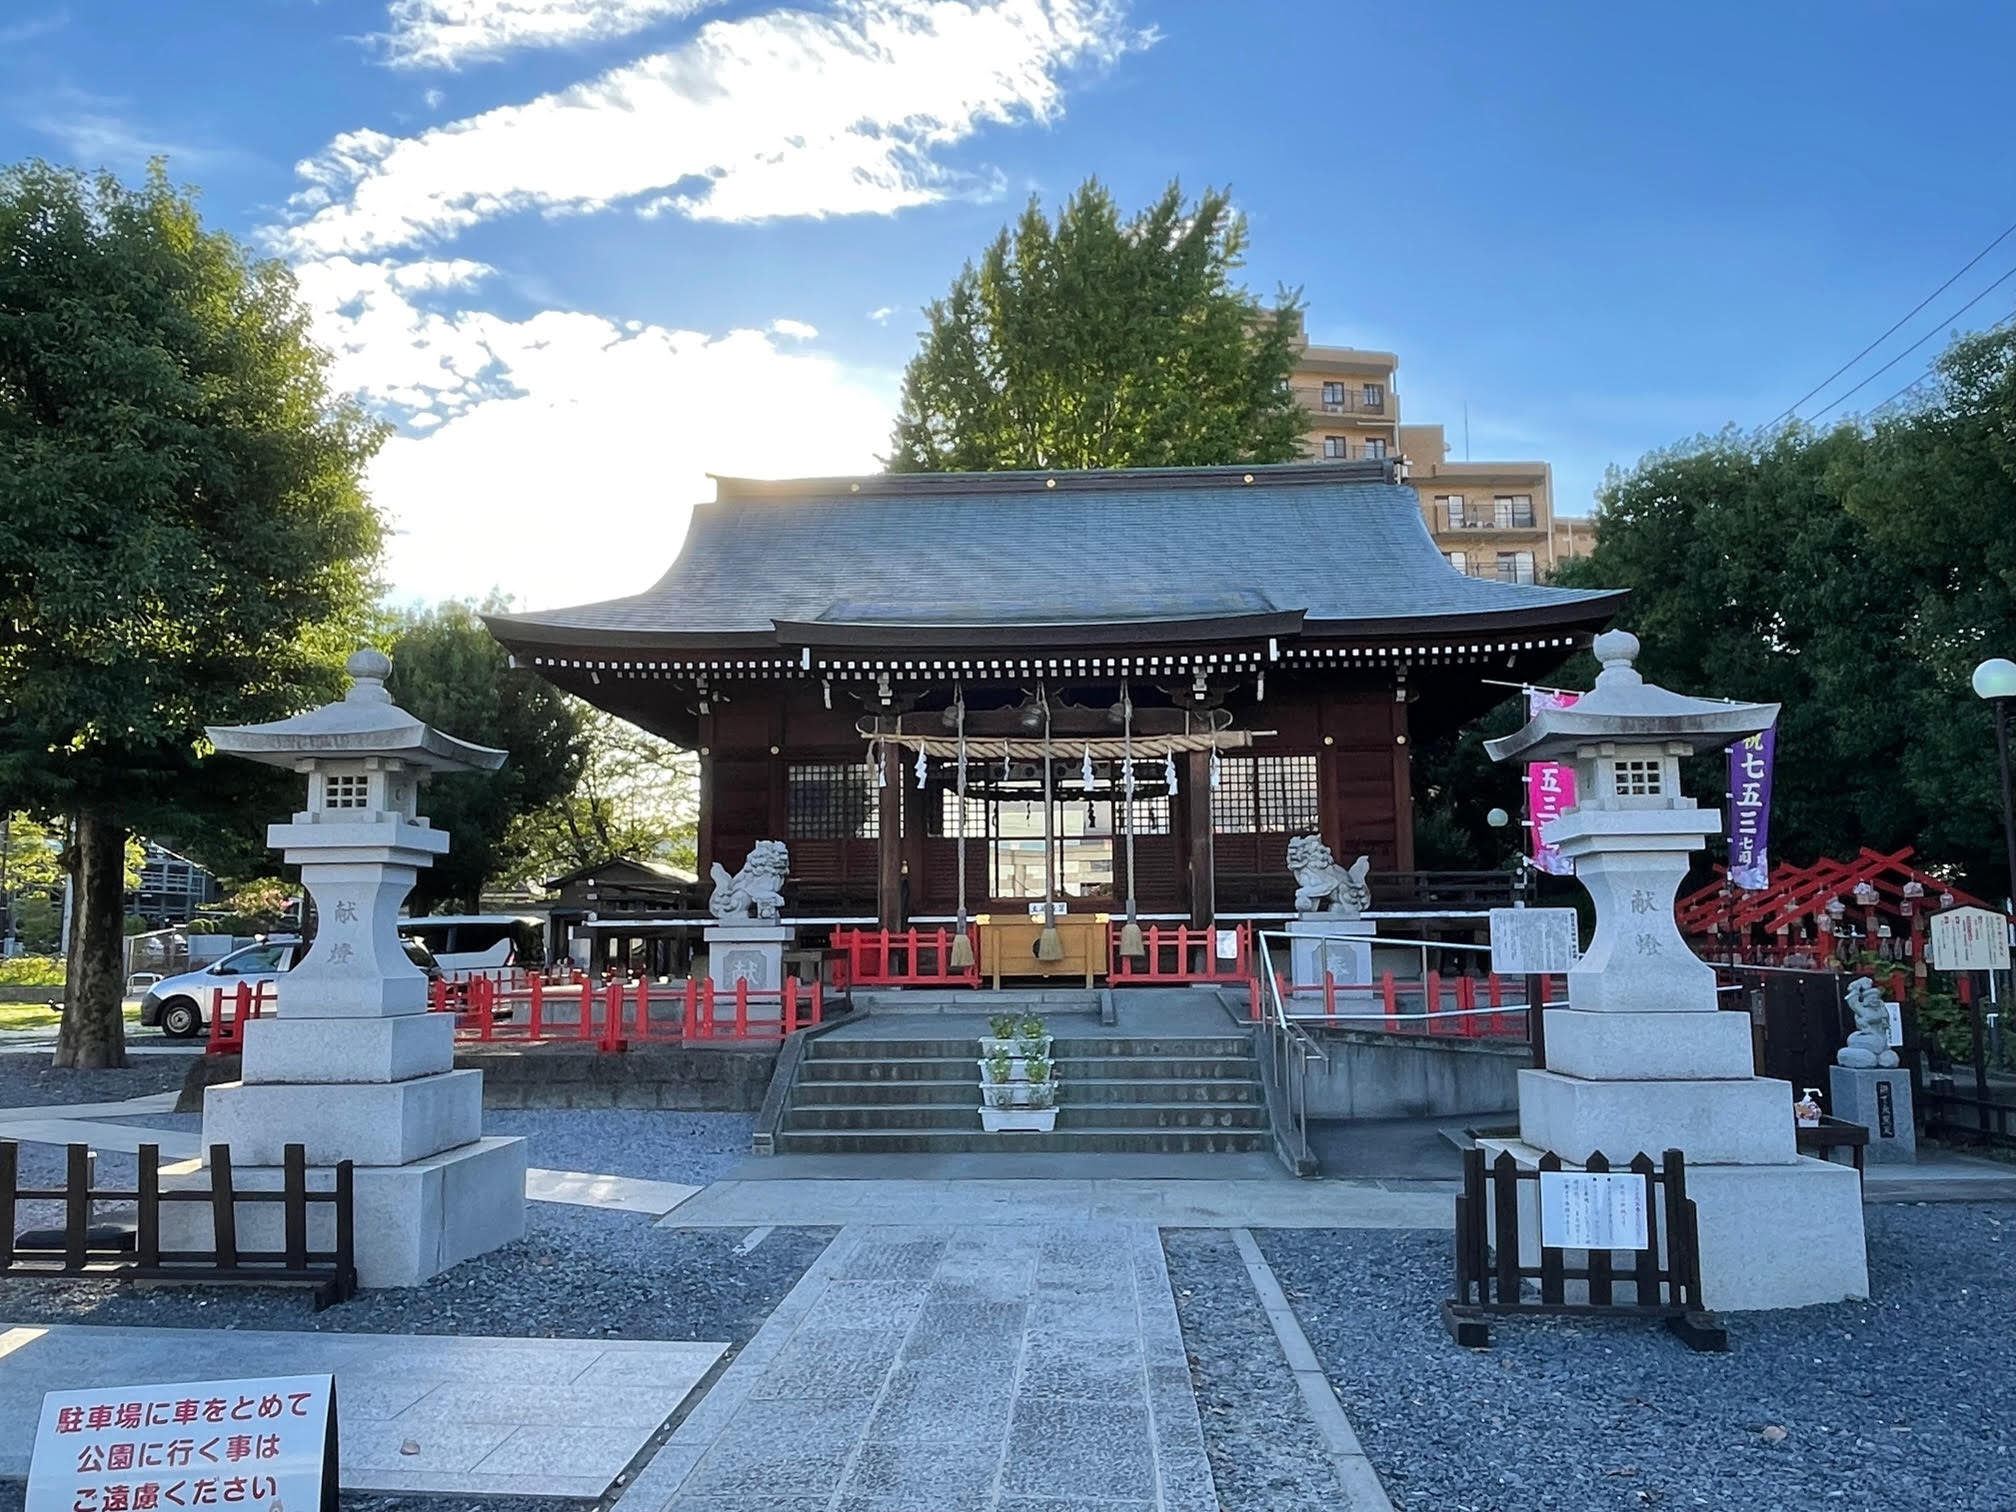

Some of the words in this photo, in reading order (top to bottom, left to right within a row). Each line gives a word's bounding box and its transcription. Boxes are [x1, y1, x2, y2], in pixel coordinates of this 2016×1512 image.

[56, 1391, 313, 1434] 駐車場に車をとめて
[76, 1433, 281, 1474] 公園に行く事は
[72, 1475, 278, 1512] ご遠慮ください
